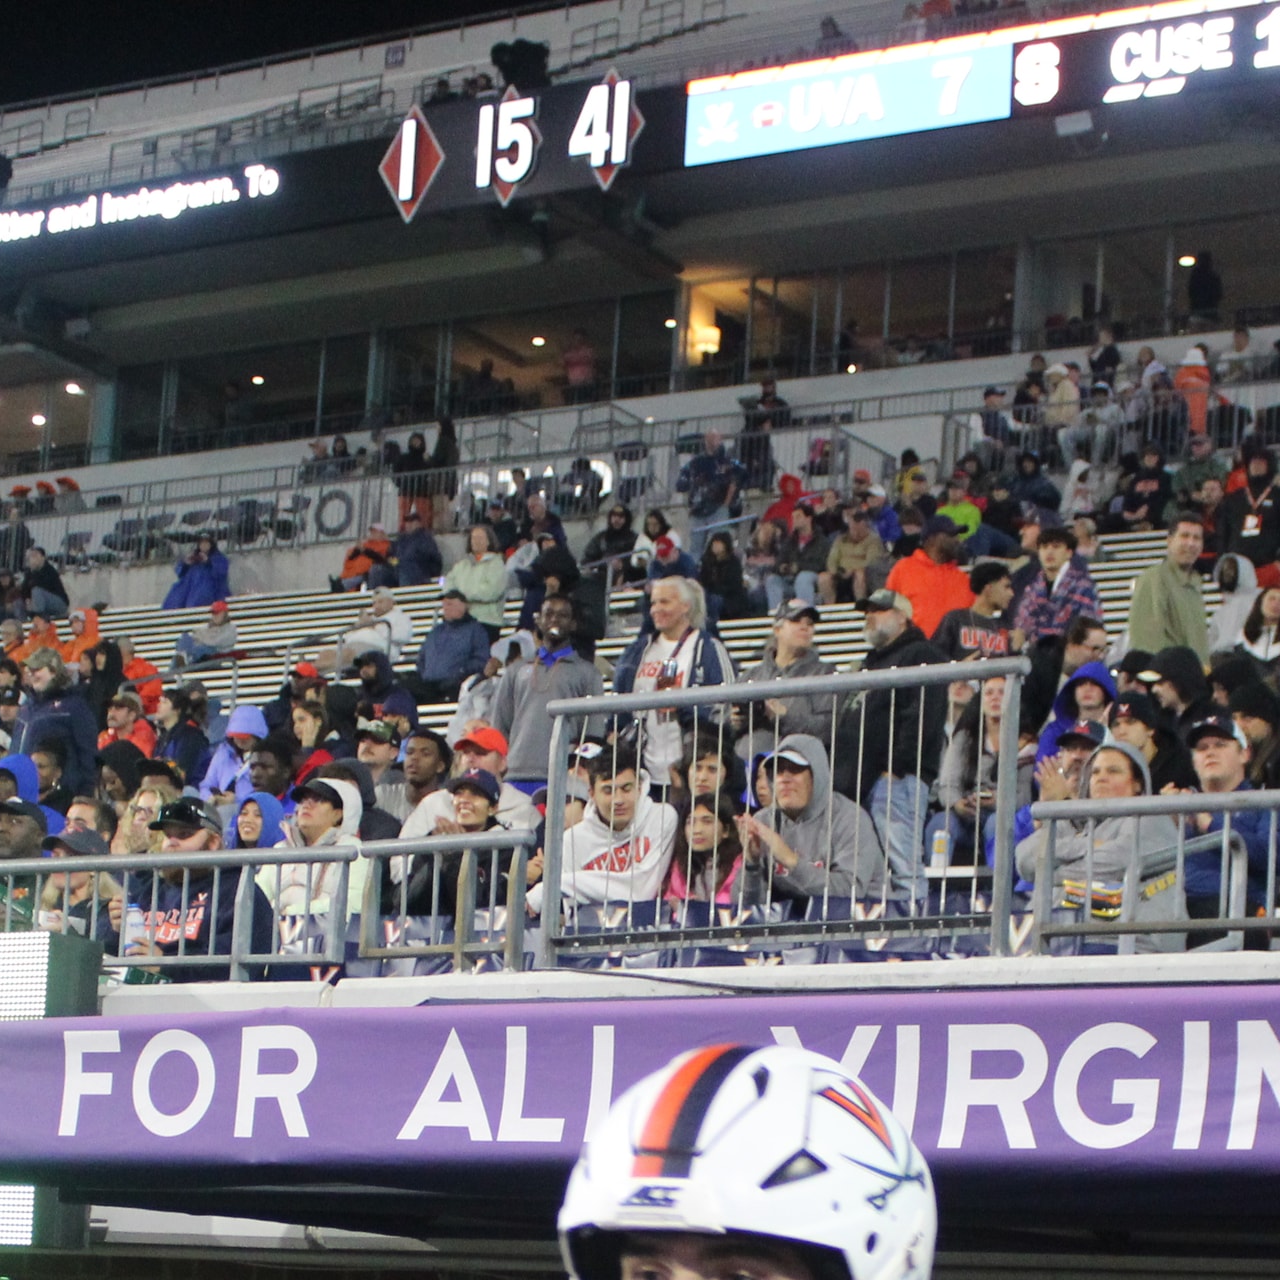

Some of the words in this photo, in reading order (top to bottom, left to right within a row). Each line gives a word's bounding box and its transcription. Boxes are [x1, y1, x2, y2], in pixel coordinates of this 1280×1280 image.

[1109, 17, 1234, 83] CUSE
[568, 80, 630, 168] 41
[789, 73, 885, 132] UVA
[932, 57, 973, 116] 7
[476, 97, 534, 187] 15
[48, 196, 97, 234] and
[100, 175, 240, 226] Instagram.
[244, 164, 279, 199] To
[58, 1026, 318, 1138] FOR
